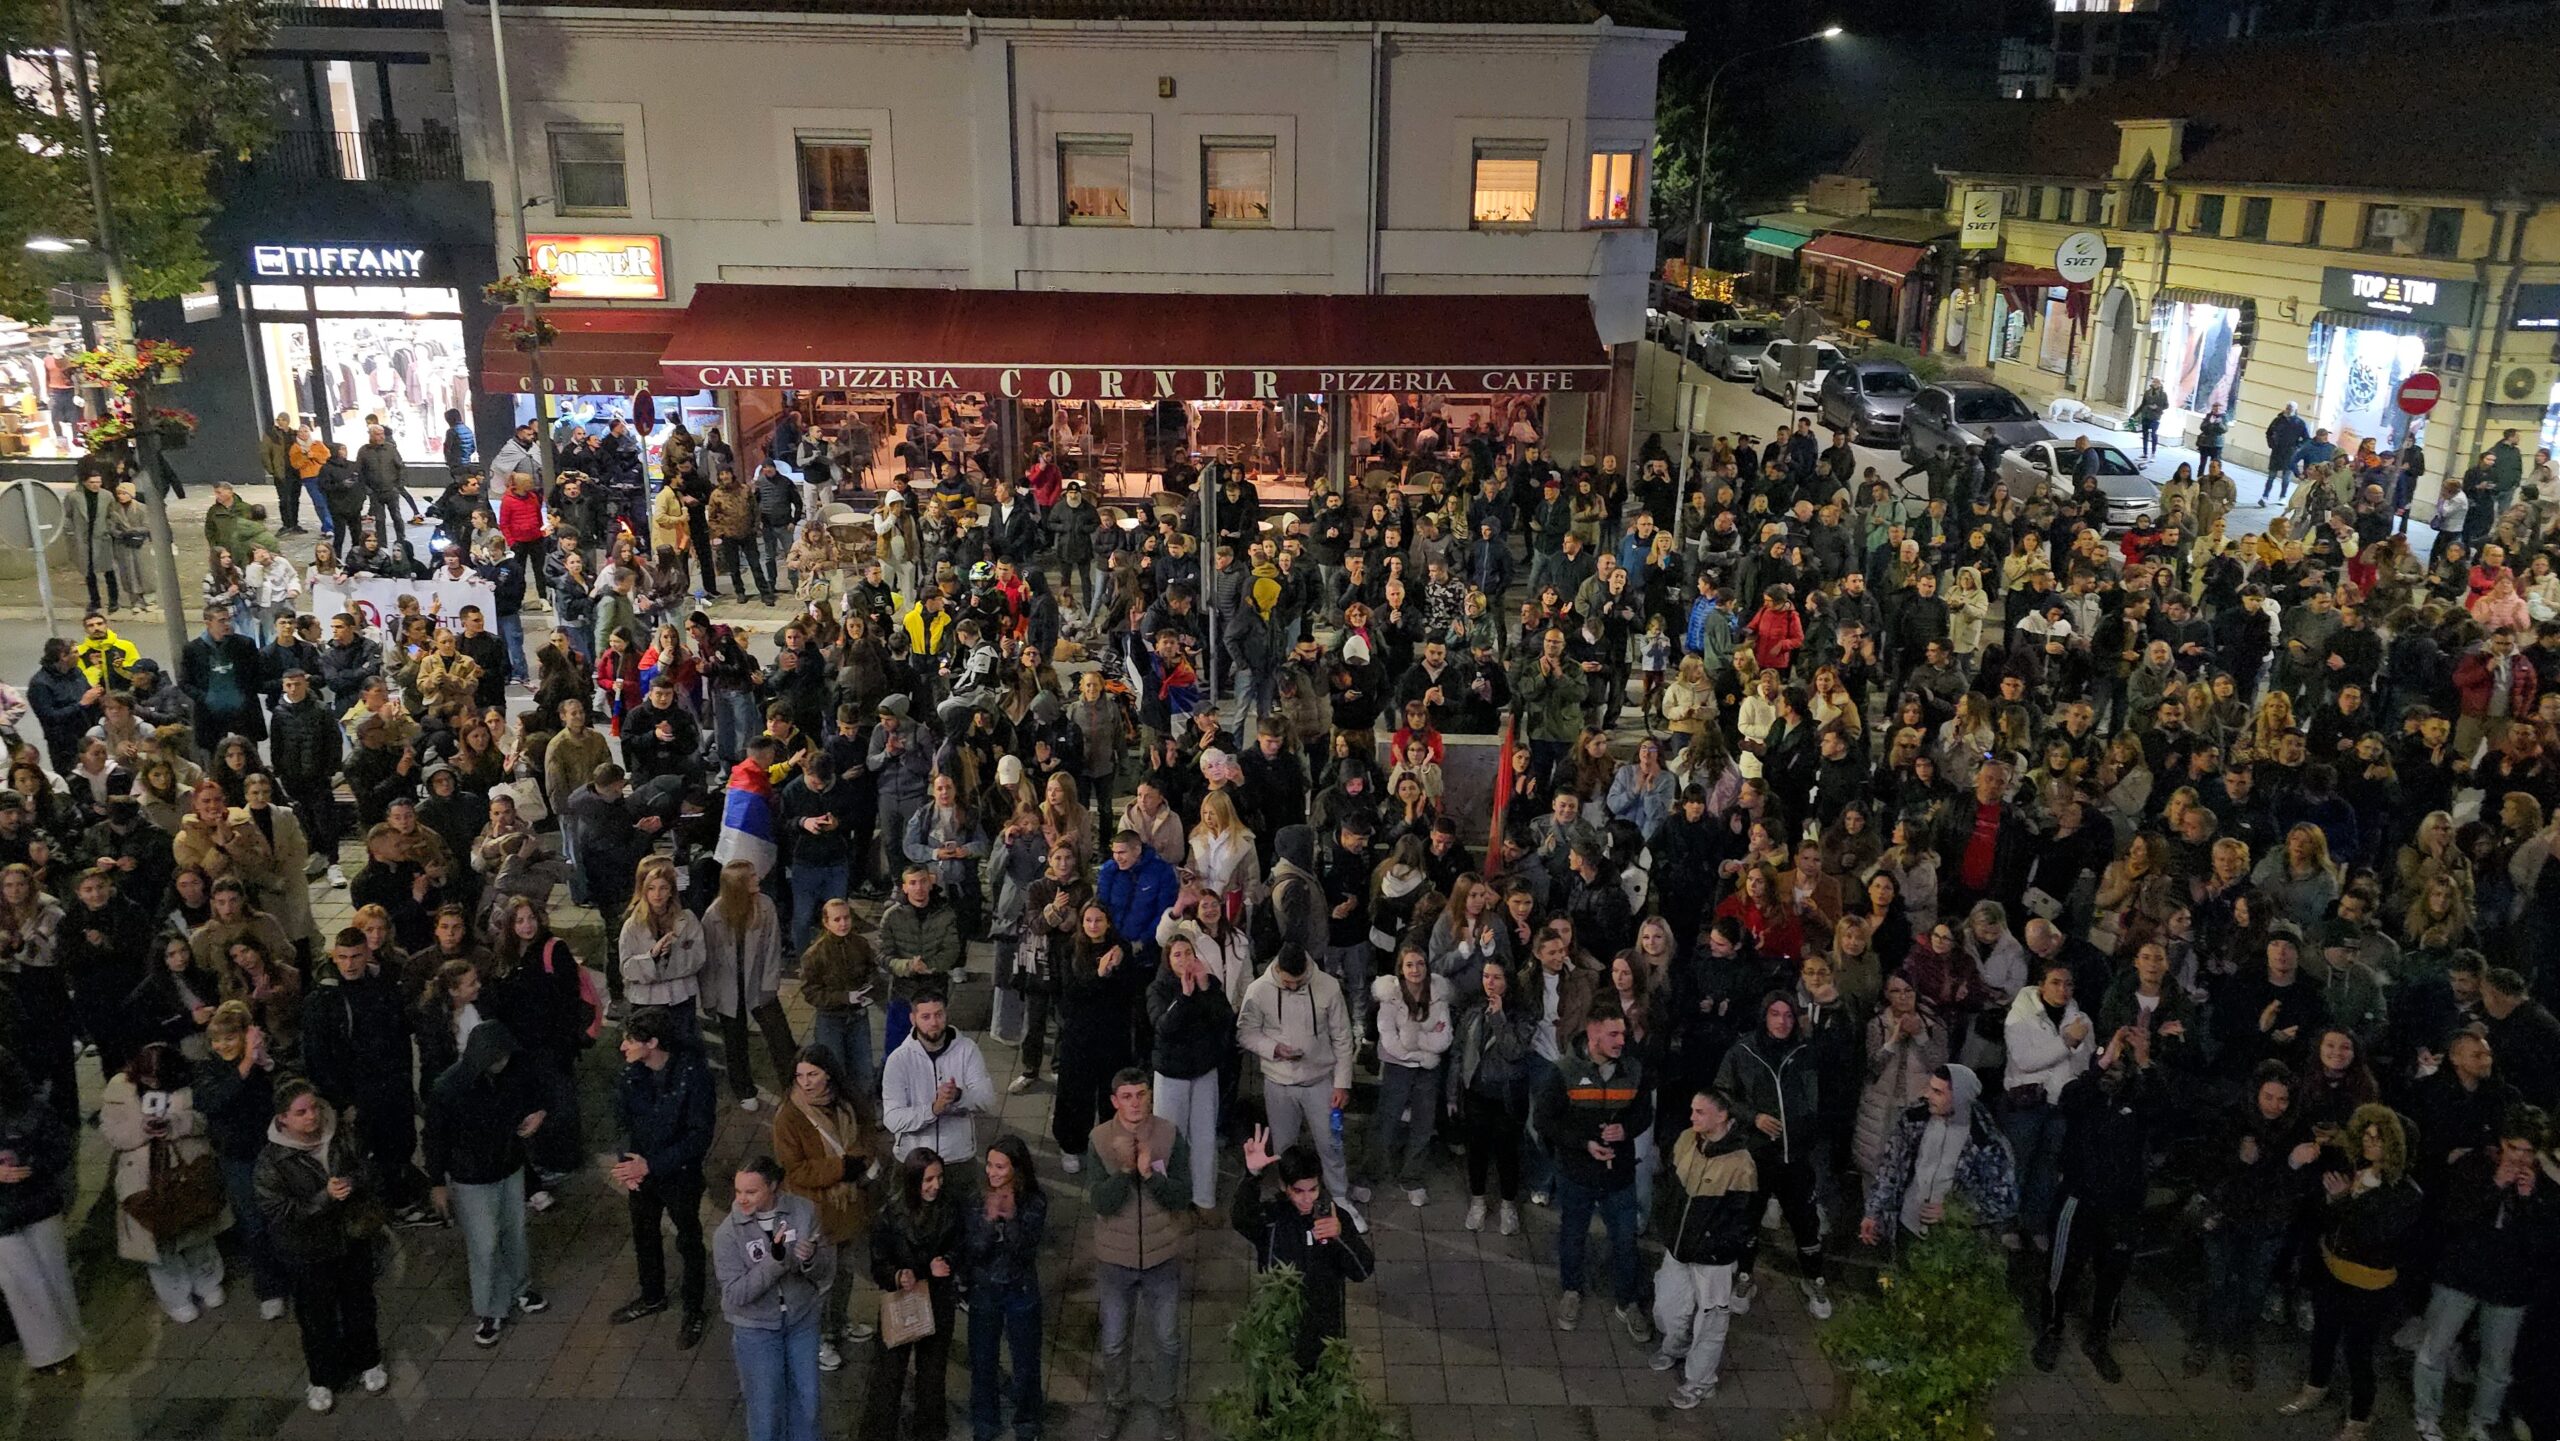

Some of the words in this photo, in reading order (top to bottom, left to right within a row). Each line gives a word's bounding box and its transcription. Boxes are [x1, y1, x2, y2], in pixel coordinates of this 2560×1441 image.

[1966, 222, 1997, 231] SVET
[286, 247, 424, 271] TIFFANY
[2064, 257, 2098, 267] SVET
[2352, 274, 2387, 298] TOP
[519, 376, 650, 393] CORNER
[699, 367, 794, 387] CAFFE
[818, 368, 960, 389] PIZZERIA
[1000, 369, 1279, 399] CORNER
[1320, 372, 1456, 391] PIZZERIA
[1481, 371, 1573, 391] CAFFE
